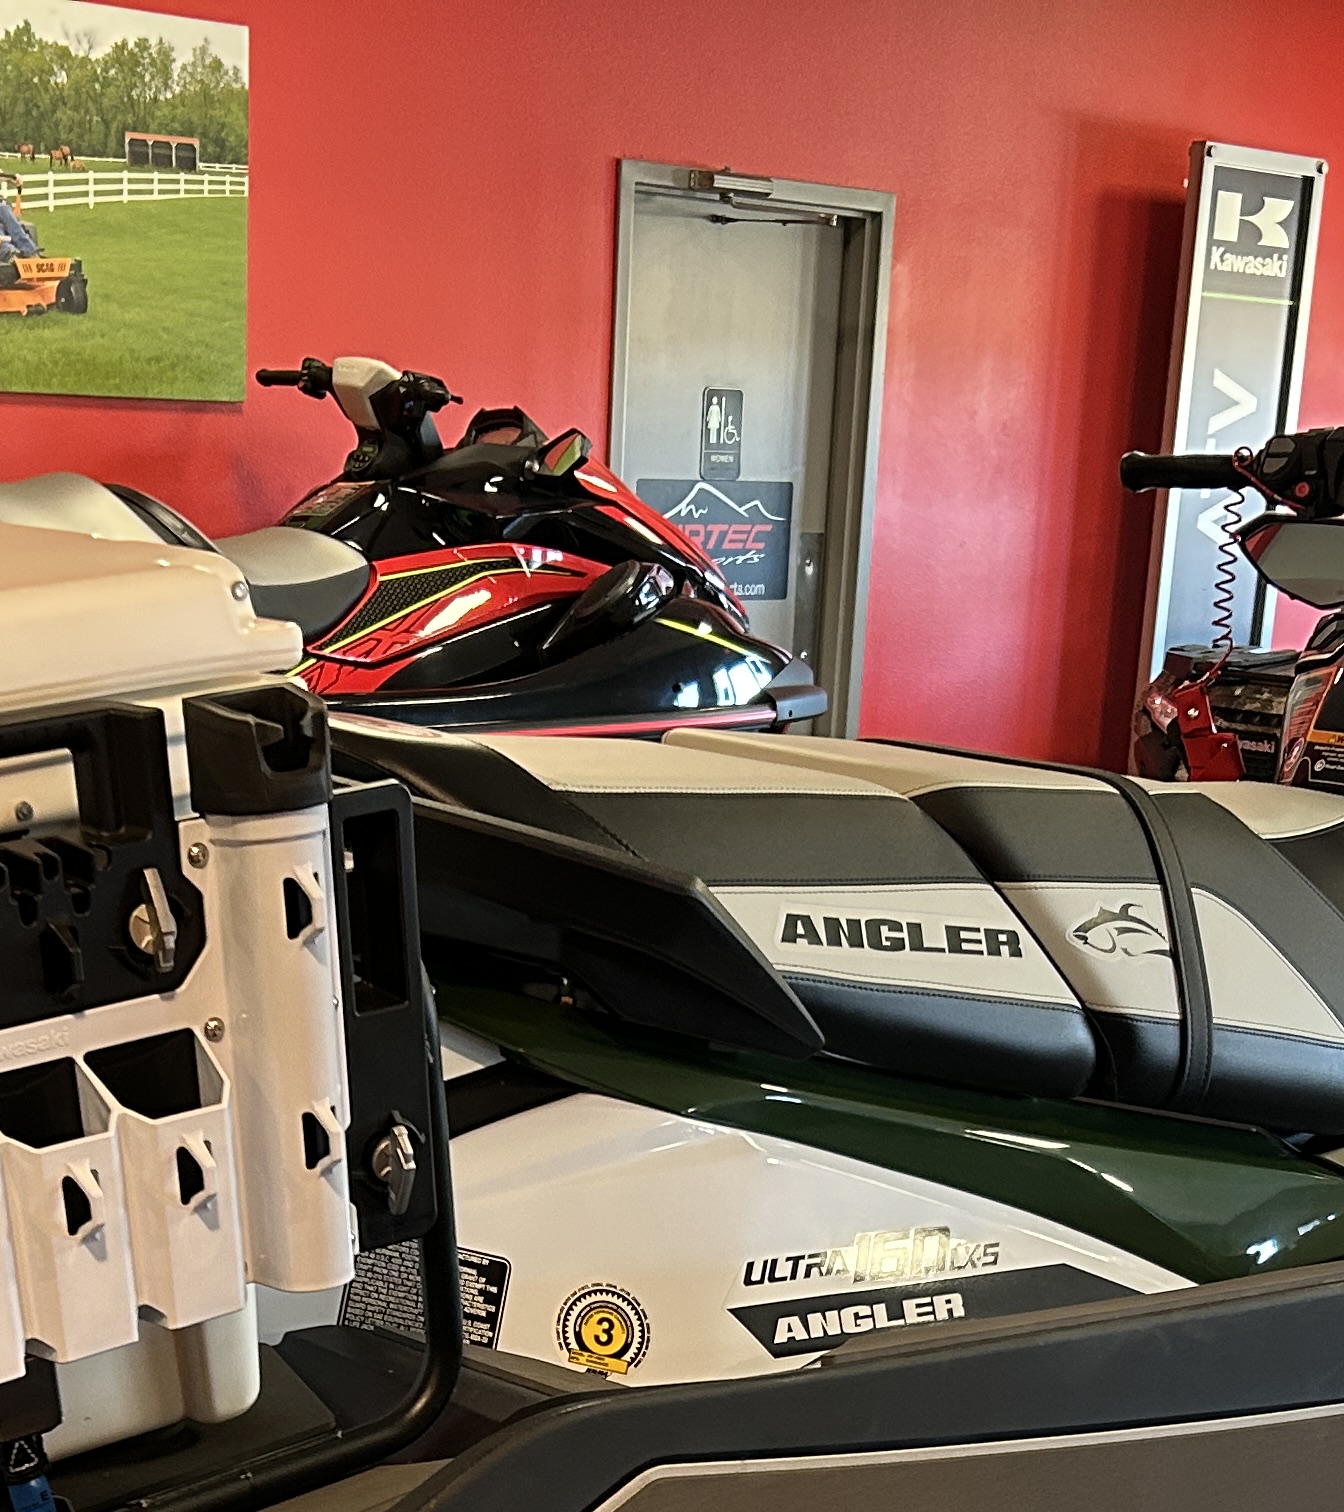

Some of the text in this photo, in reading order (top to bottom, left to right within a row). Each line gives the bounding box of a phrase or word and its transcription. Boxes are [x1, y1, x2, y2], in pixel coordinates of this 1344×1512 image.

[1209, 246, 1288, 278] Kawasaki
[1197, 368, 1258, 548] AV
[781, 913, 1022, 958] ANGLER
[743, 1250, 850, 1287] ULTRA
[852, 1226, 951, 1284] 160
[594, 1317, 614, 1346] 3
[773, 1293, 966, 1344] ANGLER
